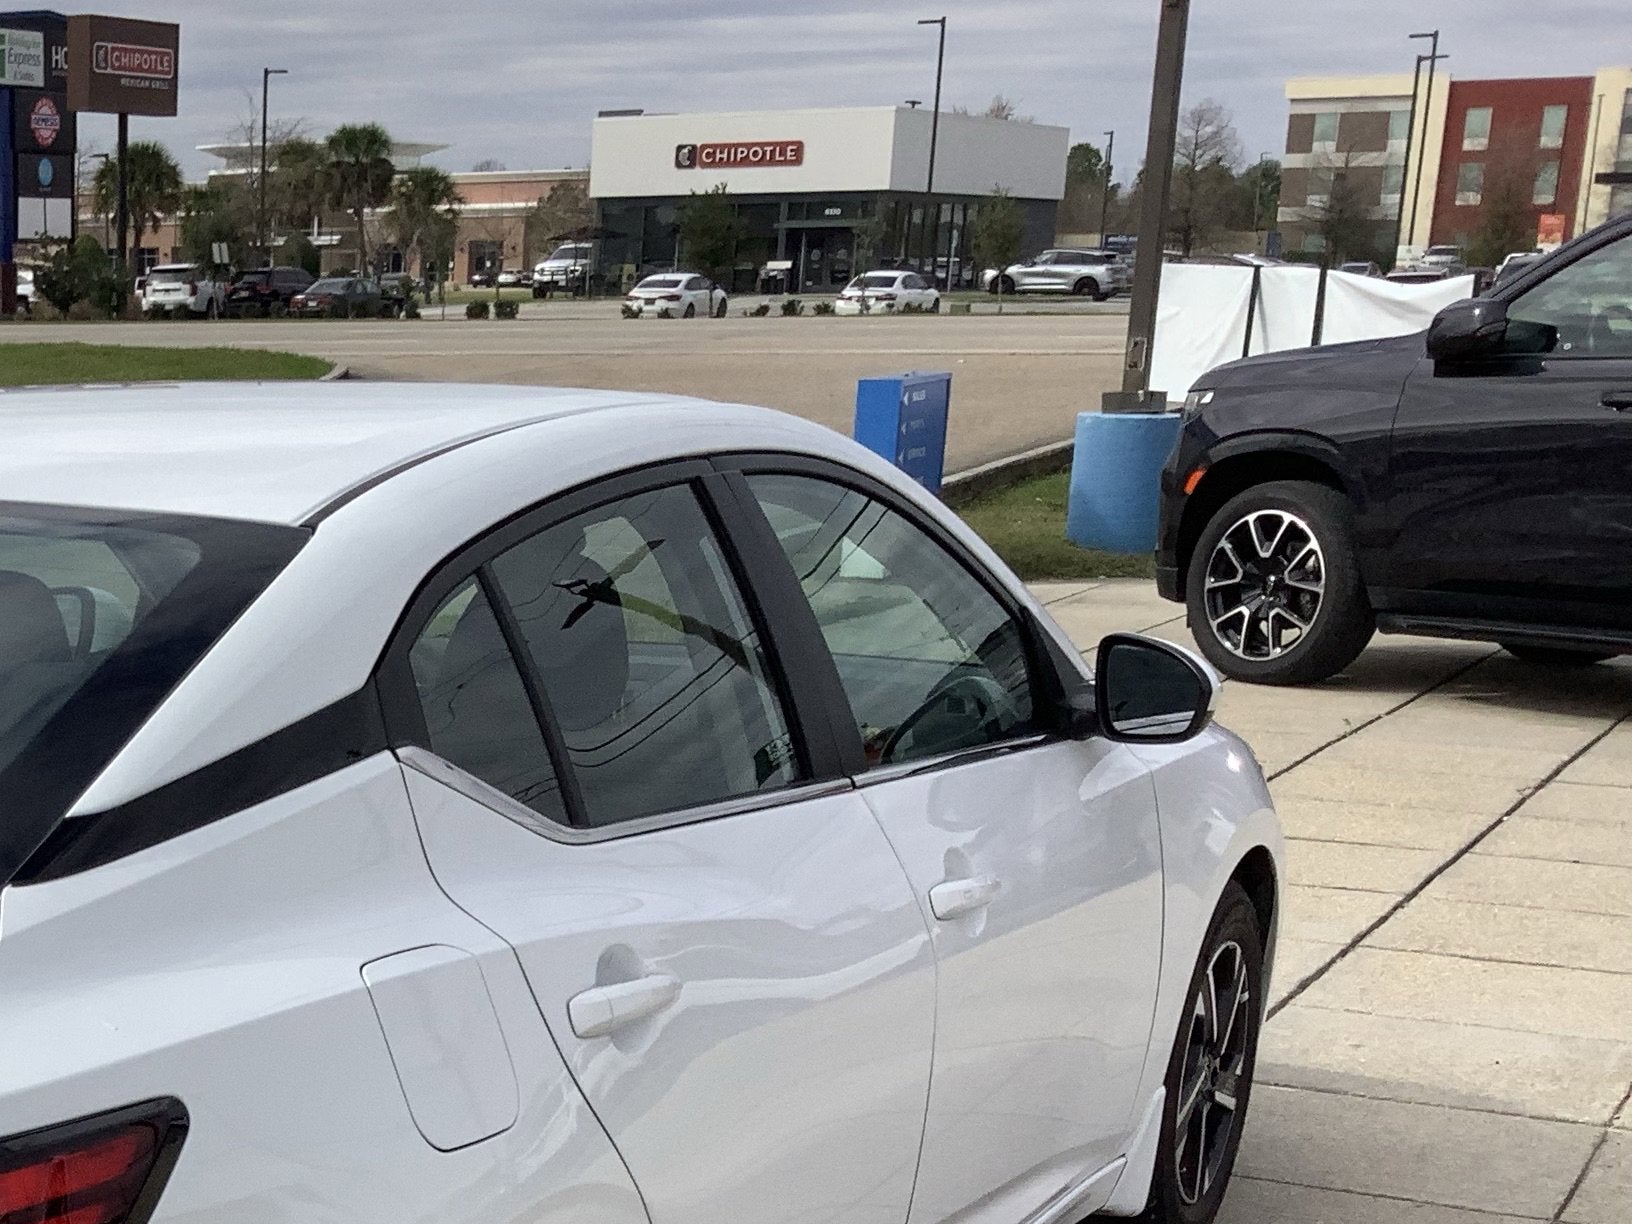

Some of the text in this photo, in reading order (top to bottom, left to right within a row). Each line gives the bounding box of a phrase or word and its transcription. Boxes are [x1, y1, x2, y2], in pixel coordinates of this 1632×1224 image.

[8, 47, 42, 68] Express
[112, 51, 170, 71] CHIPOTLE
[120, 78, 150, 88] MEXICAN
[701, 145, 798, 164] CHIPOTLE
